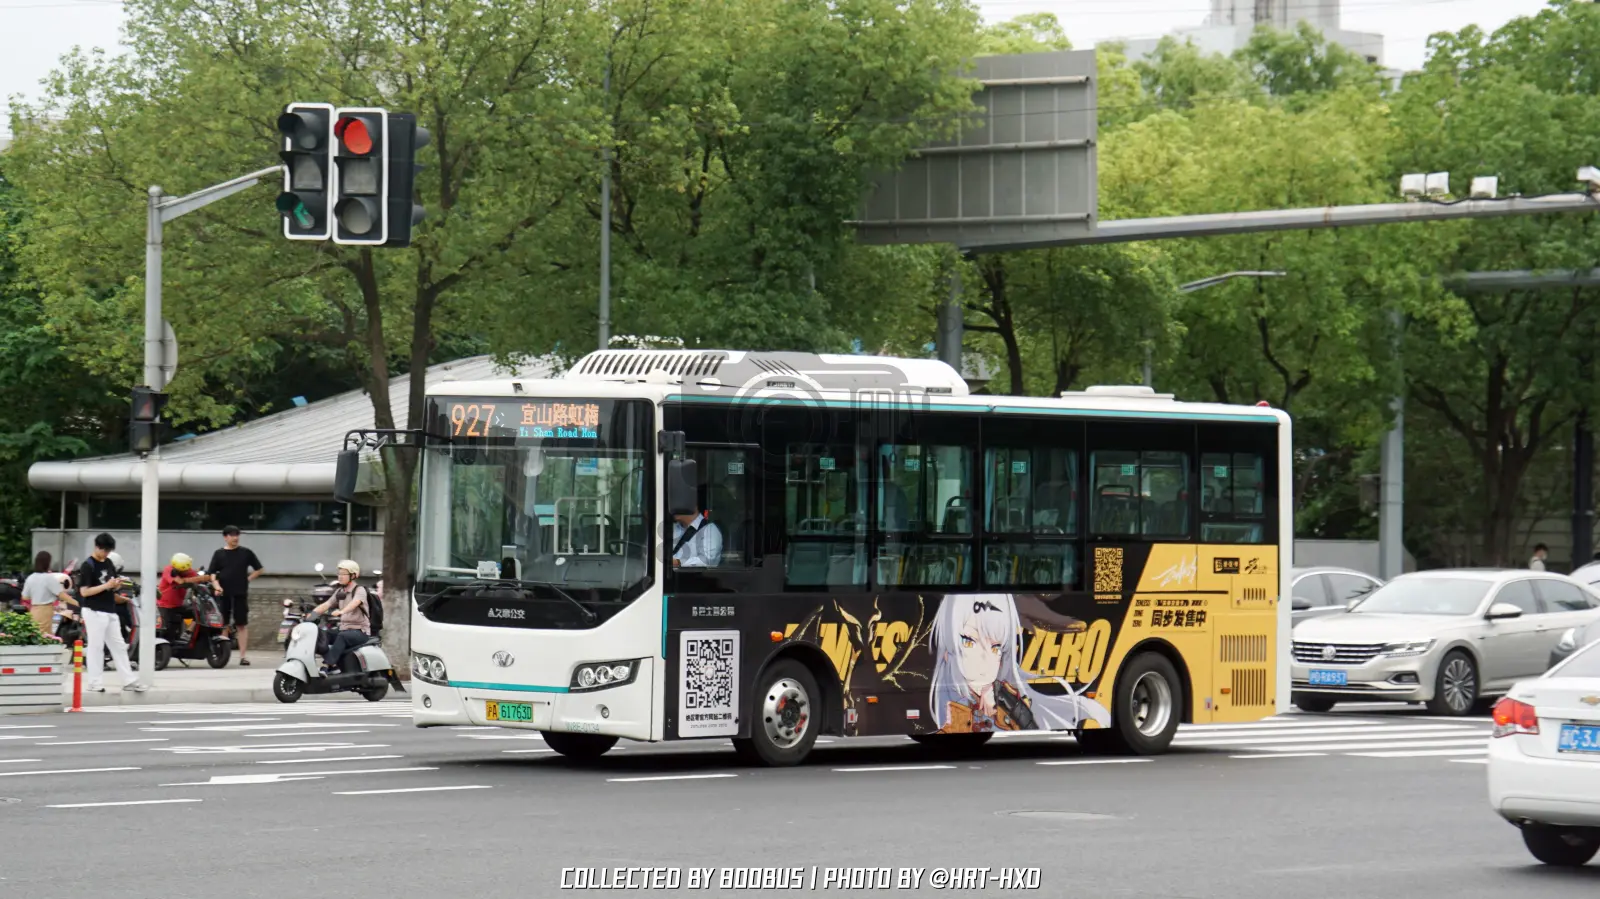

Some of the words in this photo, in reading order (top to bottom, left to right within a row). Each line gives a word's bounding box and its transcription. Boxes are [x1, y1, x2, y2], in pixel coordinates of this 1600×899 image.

[451, 404, 496, 437] 927
[519, 403, 600, 426] 宜山路虹梅
[519, 426, 529, 438] Yi
[533, 426, 554, 438] Shan
[557, 427, 578, 438] Road
[1150, 609, 1207, 628] 同步发售中
[1020, 618, 1112, 684] ZERO
